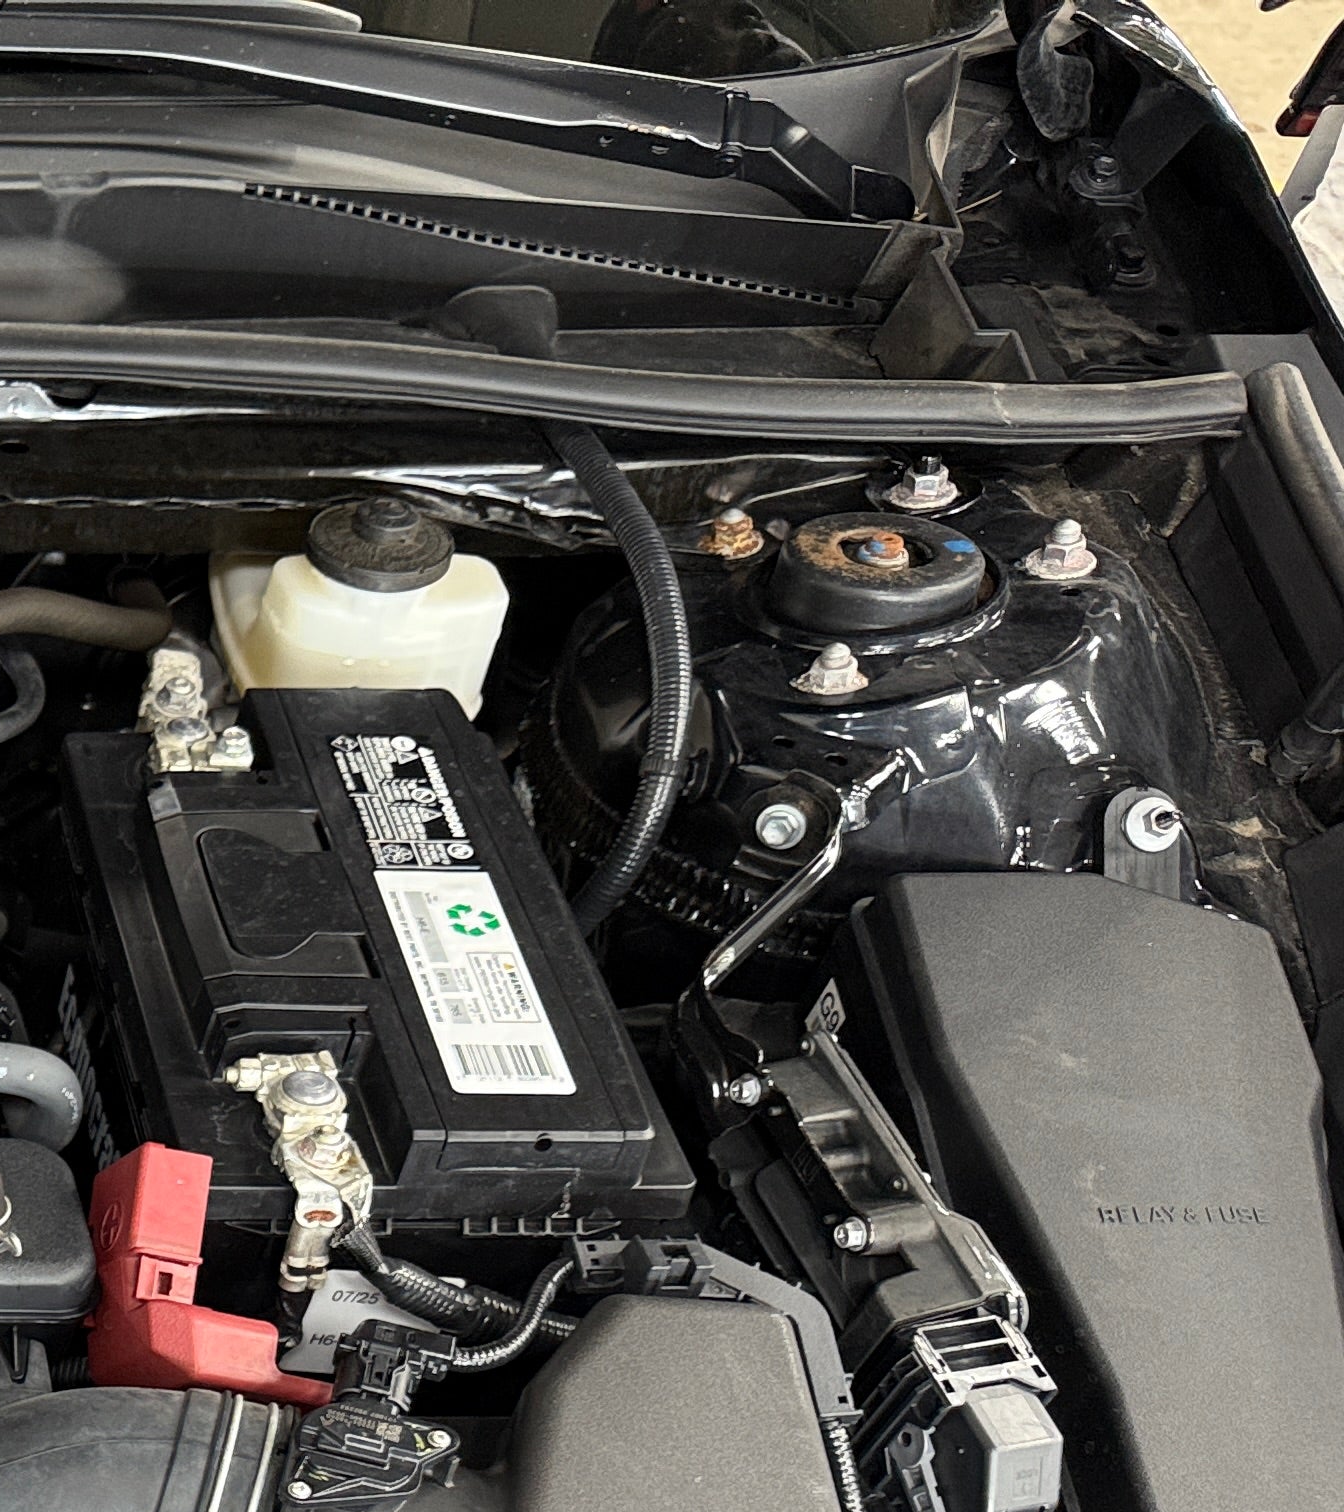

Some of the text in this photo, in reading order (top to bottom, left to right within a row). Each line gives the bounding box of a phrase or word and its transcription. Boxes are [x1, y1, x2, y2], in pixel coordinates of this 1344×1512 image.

[1097, 1206, 1269, 1224] RELAY & FUSE
[331, 1290, 379, 1304] 07/25
